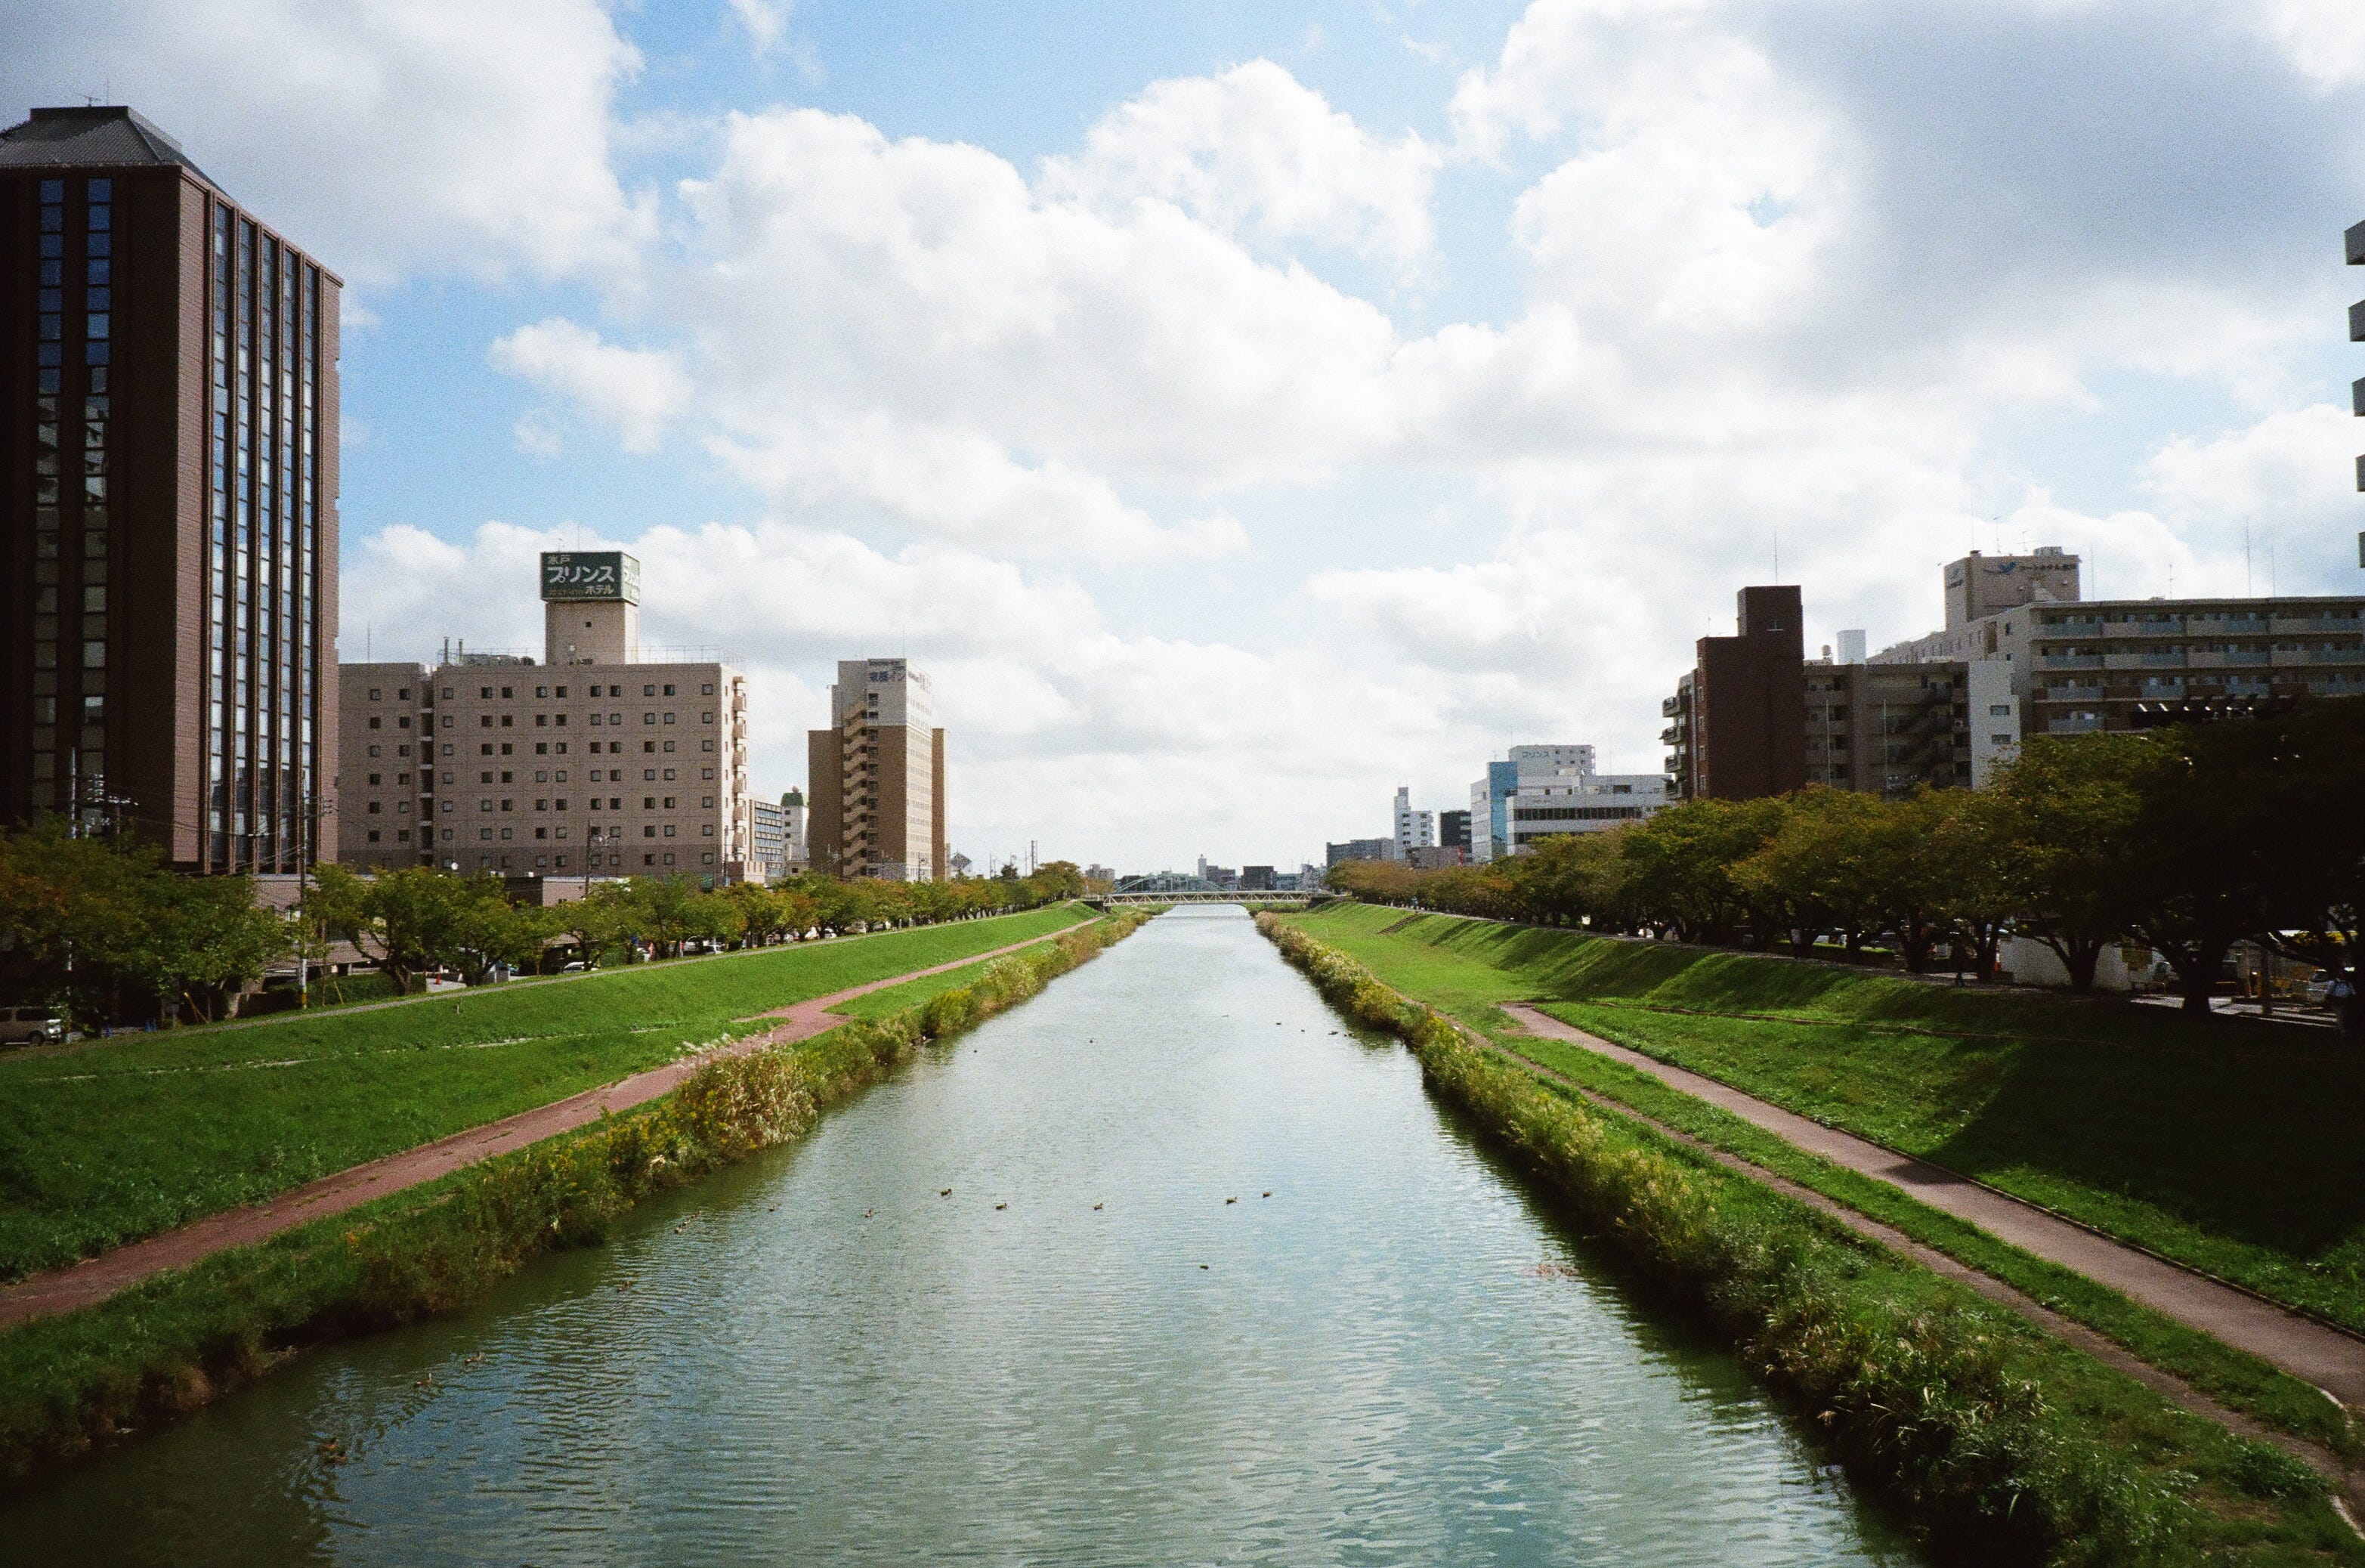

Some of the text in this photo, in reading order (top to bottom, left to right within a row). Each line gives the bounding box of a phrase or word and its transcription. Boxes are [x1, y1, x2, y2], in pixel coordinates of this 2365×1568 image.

[547, 566, 614, 583] プリンス
[585, 584, 614, 595] ホテル
